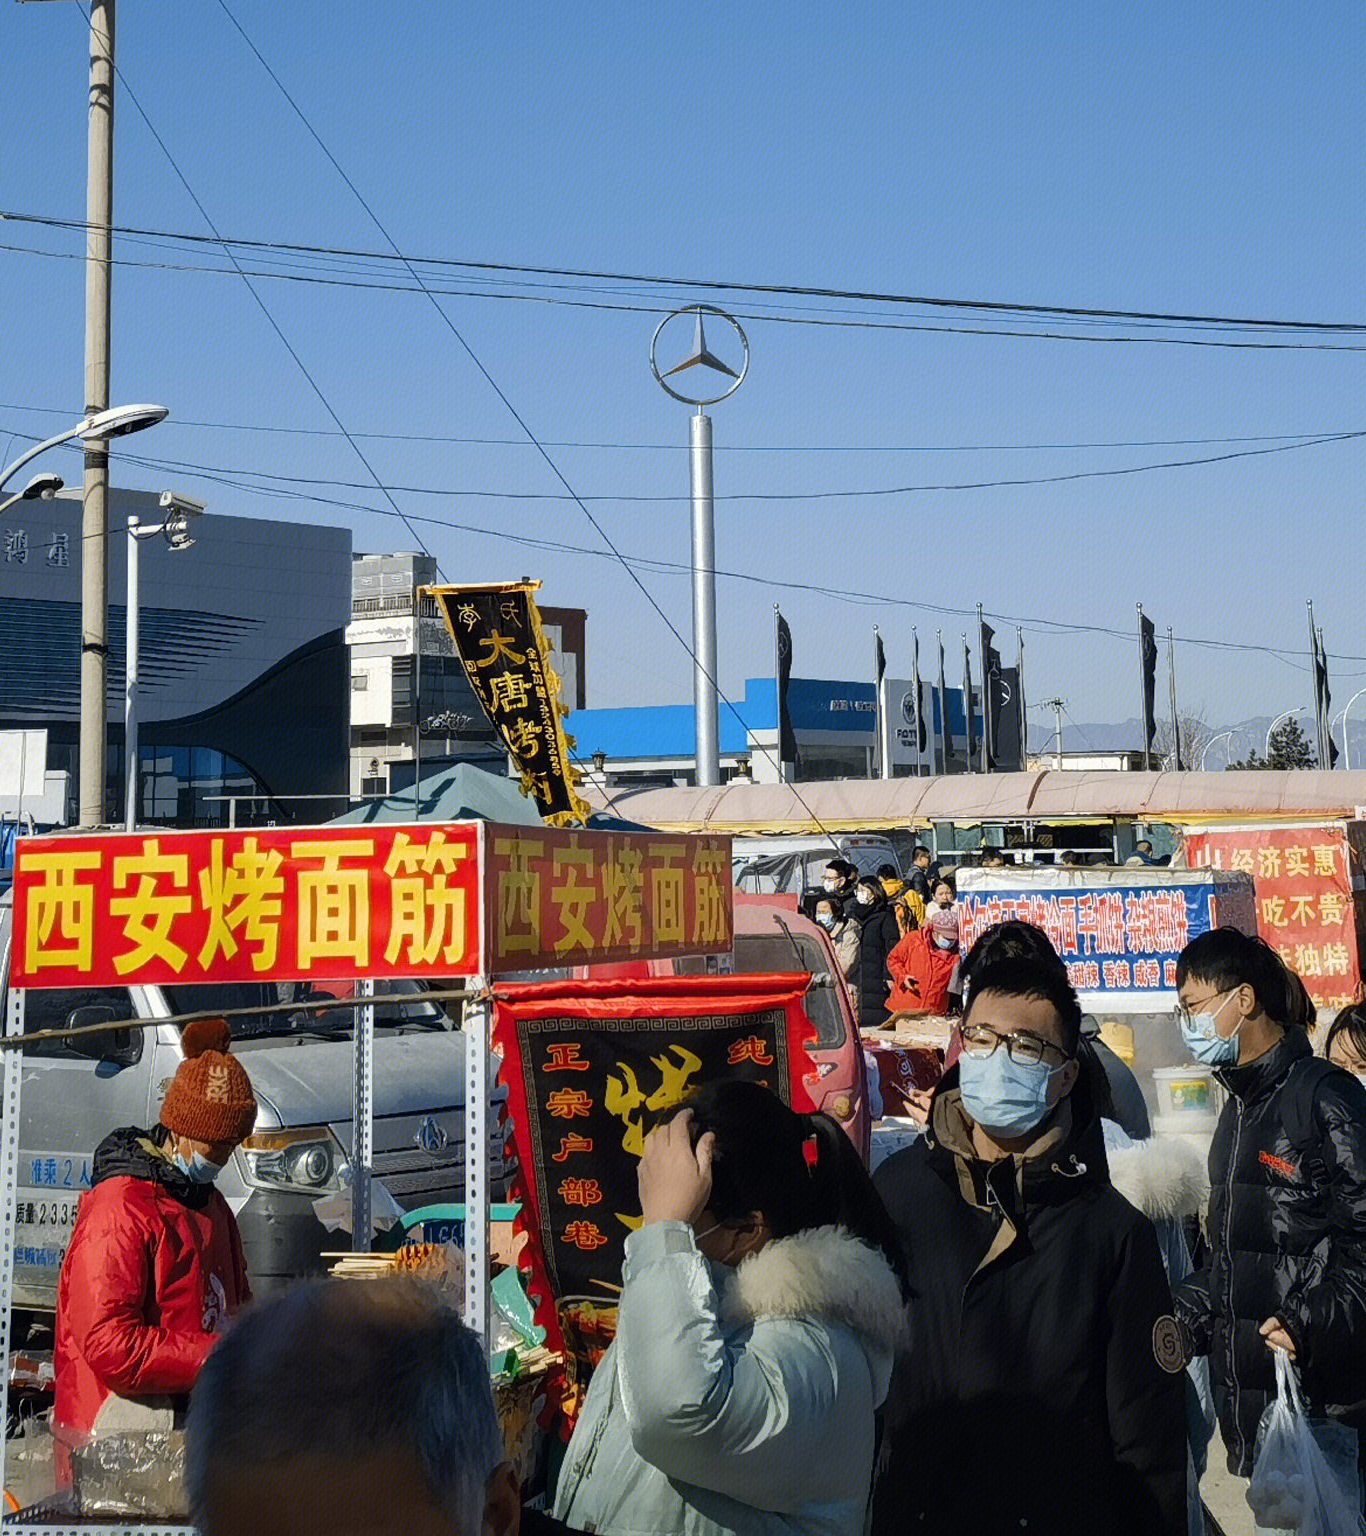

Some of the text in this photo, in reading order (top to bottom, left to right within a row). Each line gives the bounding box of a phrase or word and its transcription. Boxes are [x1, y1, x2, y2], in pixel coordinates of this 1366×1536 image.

[19, 830, 468, 976] 西安烤面筋
[494, 832, 731, 961] 西安烤面筋
[1230, 843, 1340, 880] 经济实惠
[1256, 892, 1347, 929] 吃不贵
[542, 1041, 608, 1250] 正宗户部巷
